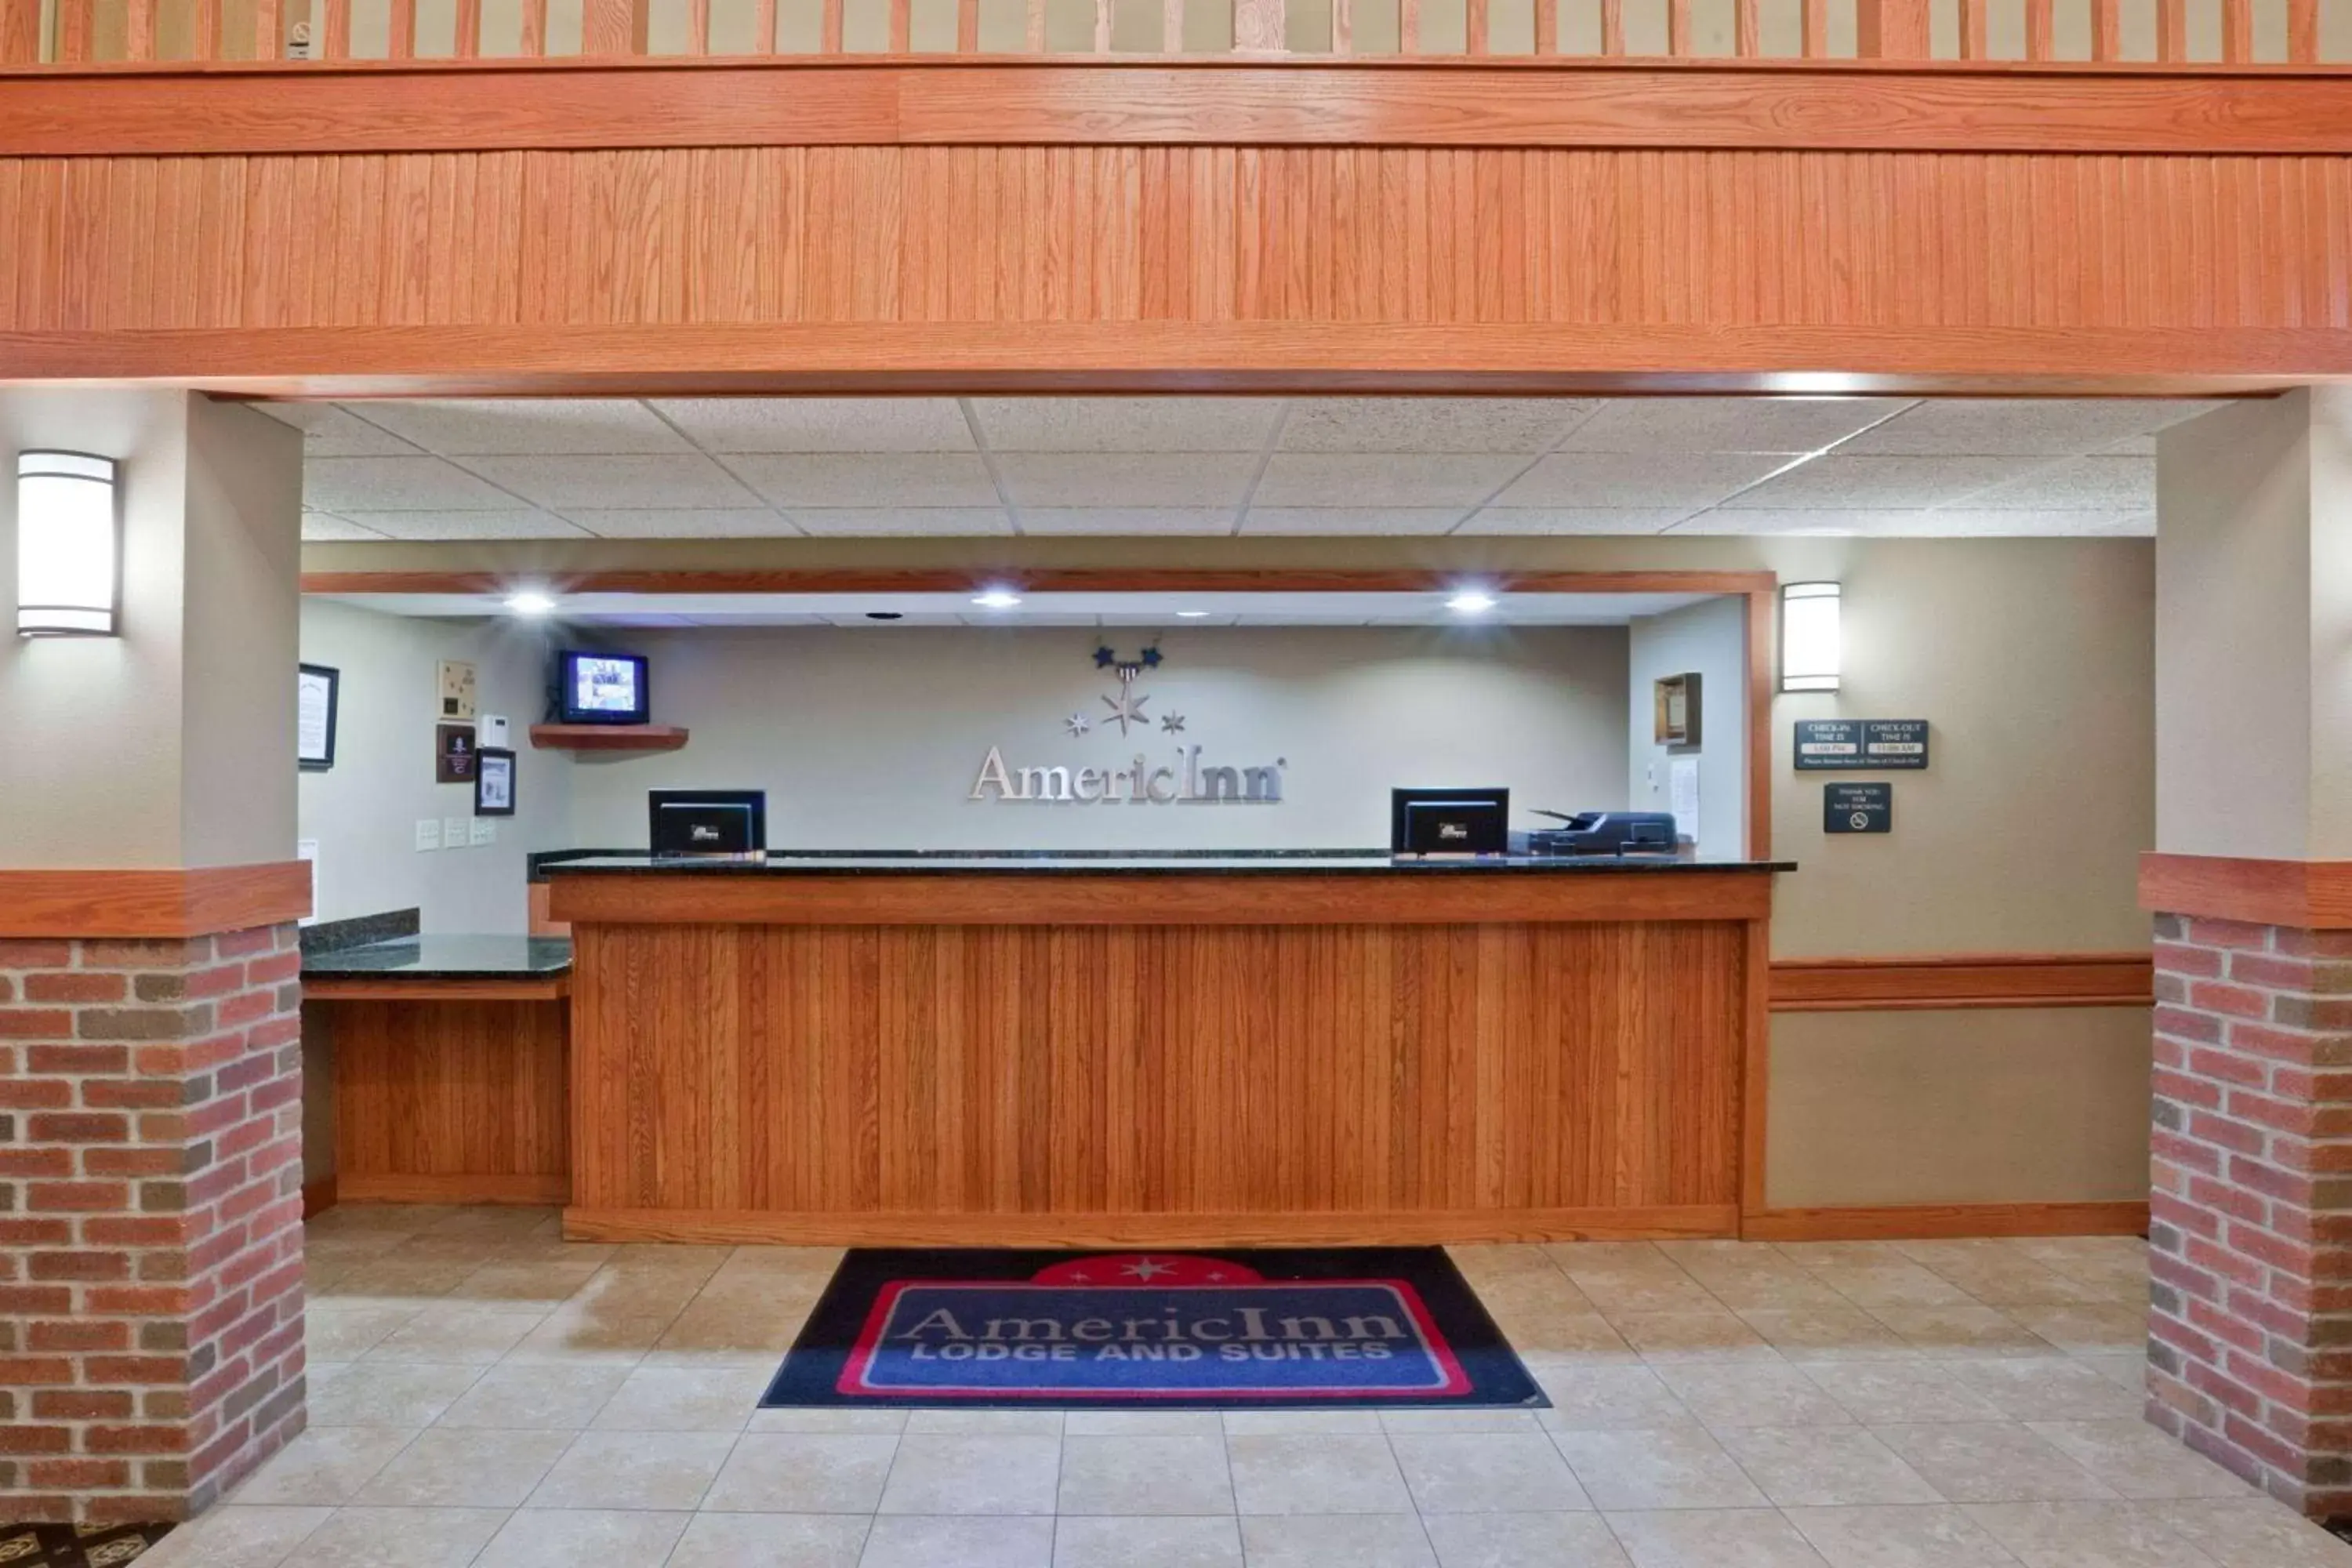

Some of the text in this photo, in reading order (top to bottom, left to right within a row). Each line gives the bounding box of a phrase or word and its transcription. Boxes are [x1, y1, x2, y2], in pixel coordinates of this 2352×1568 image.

[967, 745, 1283, 804] AmericInn
[892, 1307, 1408, 1341] AmericInn
[910, 1341, 1394, 1362] LODGE AND SUITES
